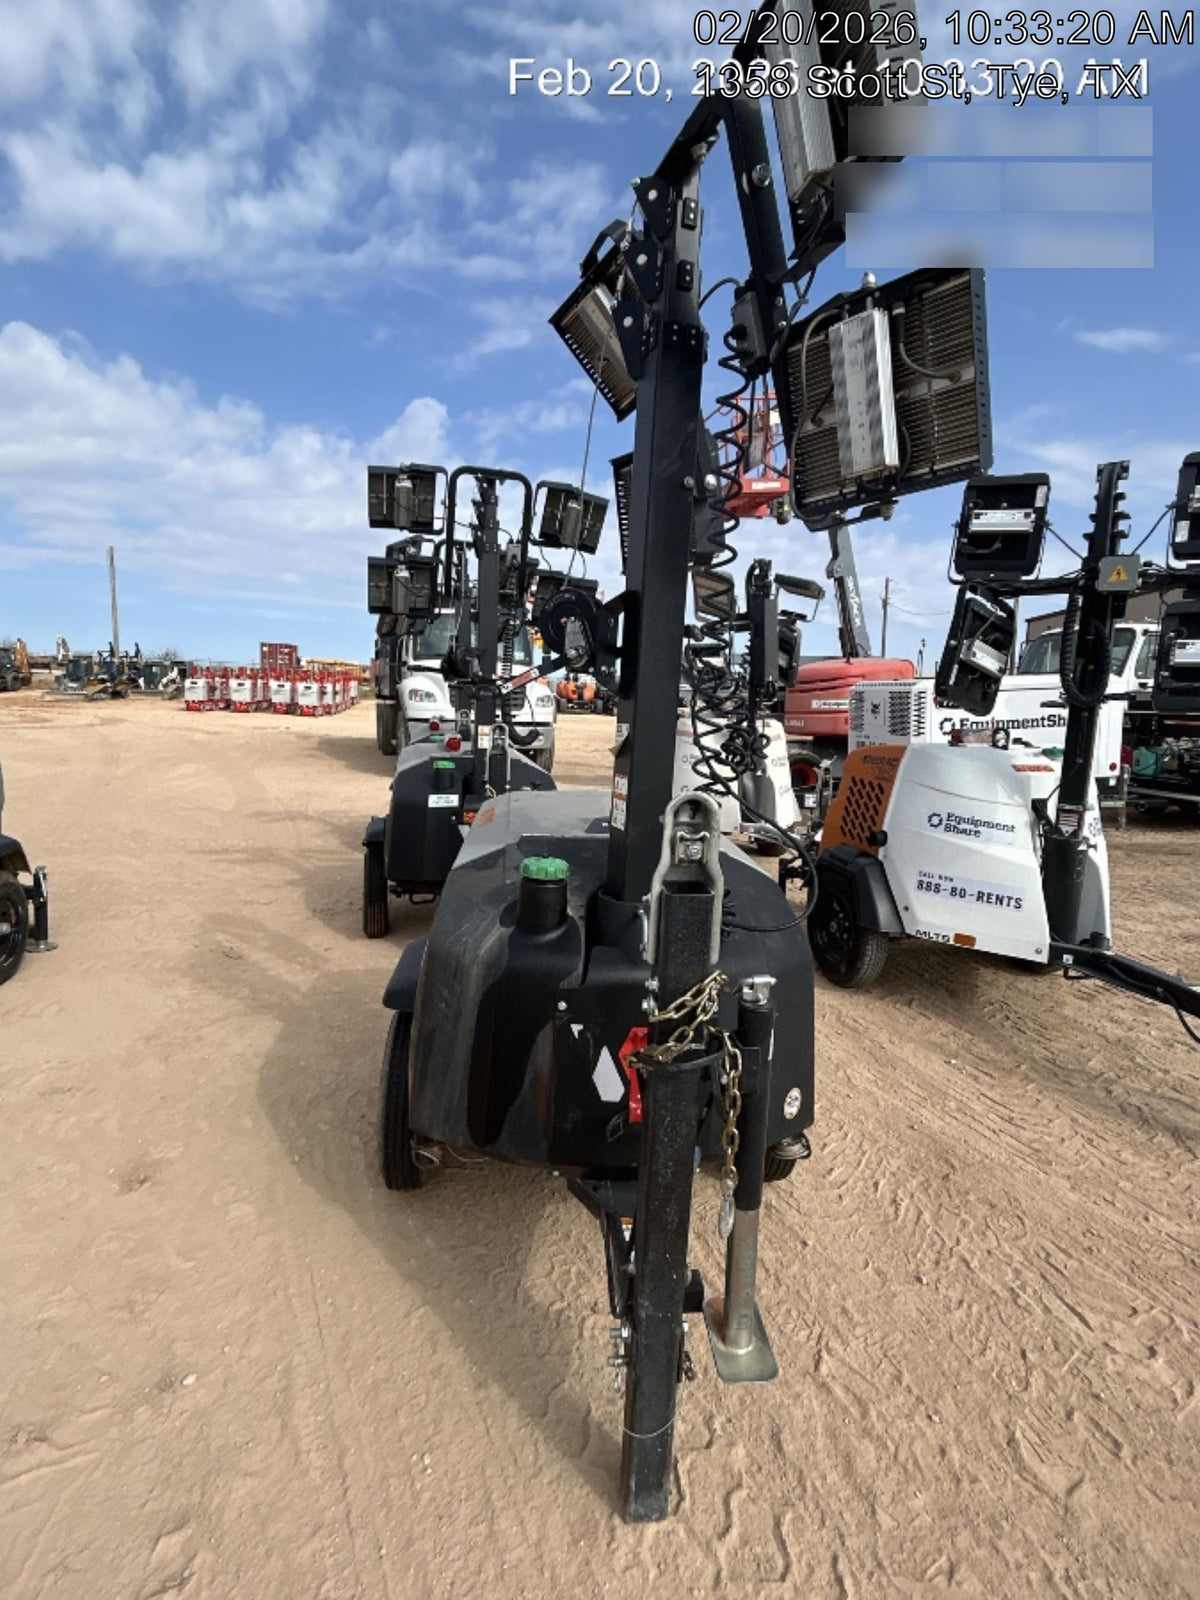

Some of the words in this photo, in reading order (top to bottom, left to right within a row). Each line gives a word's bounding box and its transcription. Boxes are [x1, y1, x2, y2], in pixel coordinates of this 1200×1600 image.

[959, 713, 1067, 730] EquipmentSh
[943, 822, 982, 838] Share
[945, 811, 1017, 833] Equipment
[916, 879, 1023, 910] 888-80-RENTS
